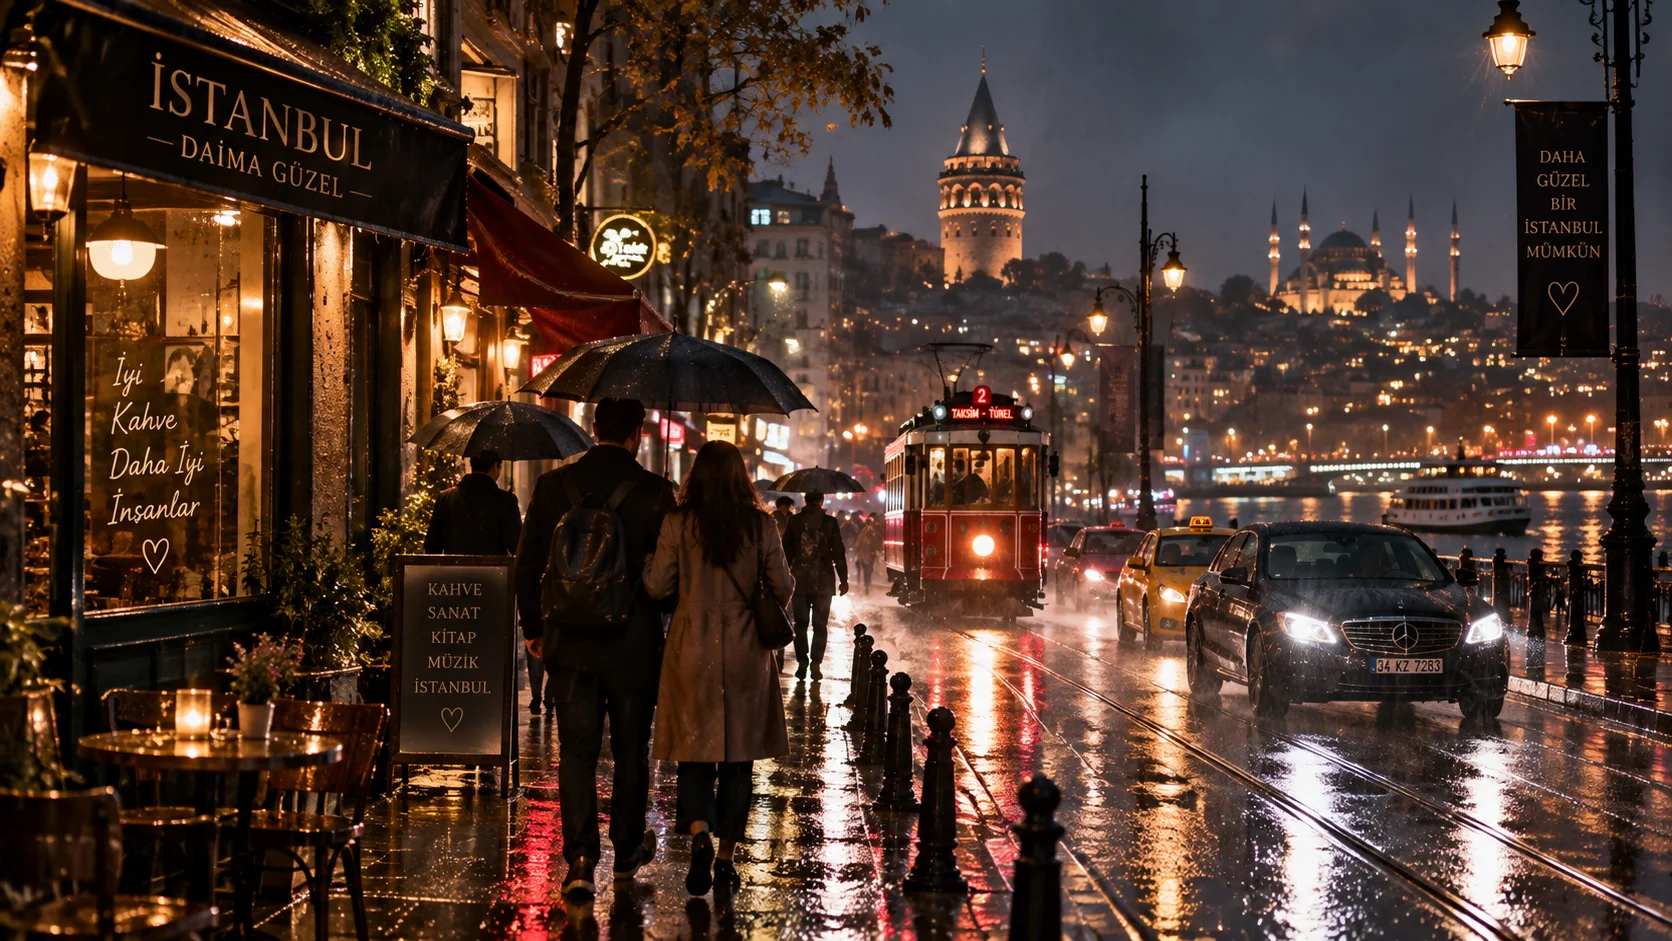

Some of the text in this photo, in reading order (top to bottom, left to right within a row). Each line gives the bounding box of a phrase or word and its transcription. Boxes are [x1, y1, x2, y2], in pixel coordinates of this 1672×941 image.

[150, 51, 372, 170] İSTANBUL
[1540, 150, 1586, 164] DAHA
[181, 134, 343, 199] DAİMA GÜZEL
[1536, 170, 1590, 188] GÜZEL
[1550, 194, 1577, 211] BİR
[1524, 218, 1603, 235] İSTANBUL
[1526, 241, 1601, 259] MÜMKÜN
[112, 351, 143, 397] İyi
[977, 388, 987, 403] 2
[110, 401, 178, 435] Kahve
[951, 406, 980, 419] TAKSİM
[109, 440, 205, 486] Daha İyi
[427, 582, 482, 596] KAHVE
[427, 605, 481, 619] SANAT
[431, 628, 477, 644] KİTAP
[427, 653, 479, 669] MÜZİK
[1377, 660, 1390, 672] 34
[1395, 660, 1410, 672] KZ
[414, 677, 492, 694] İSTANBUL
